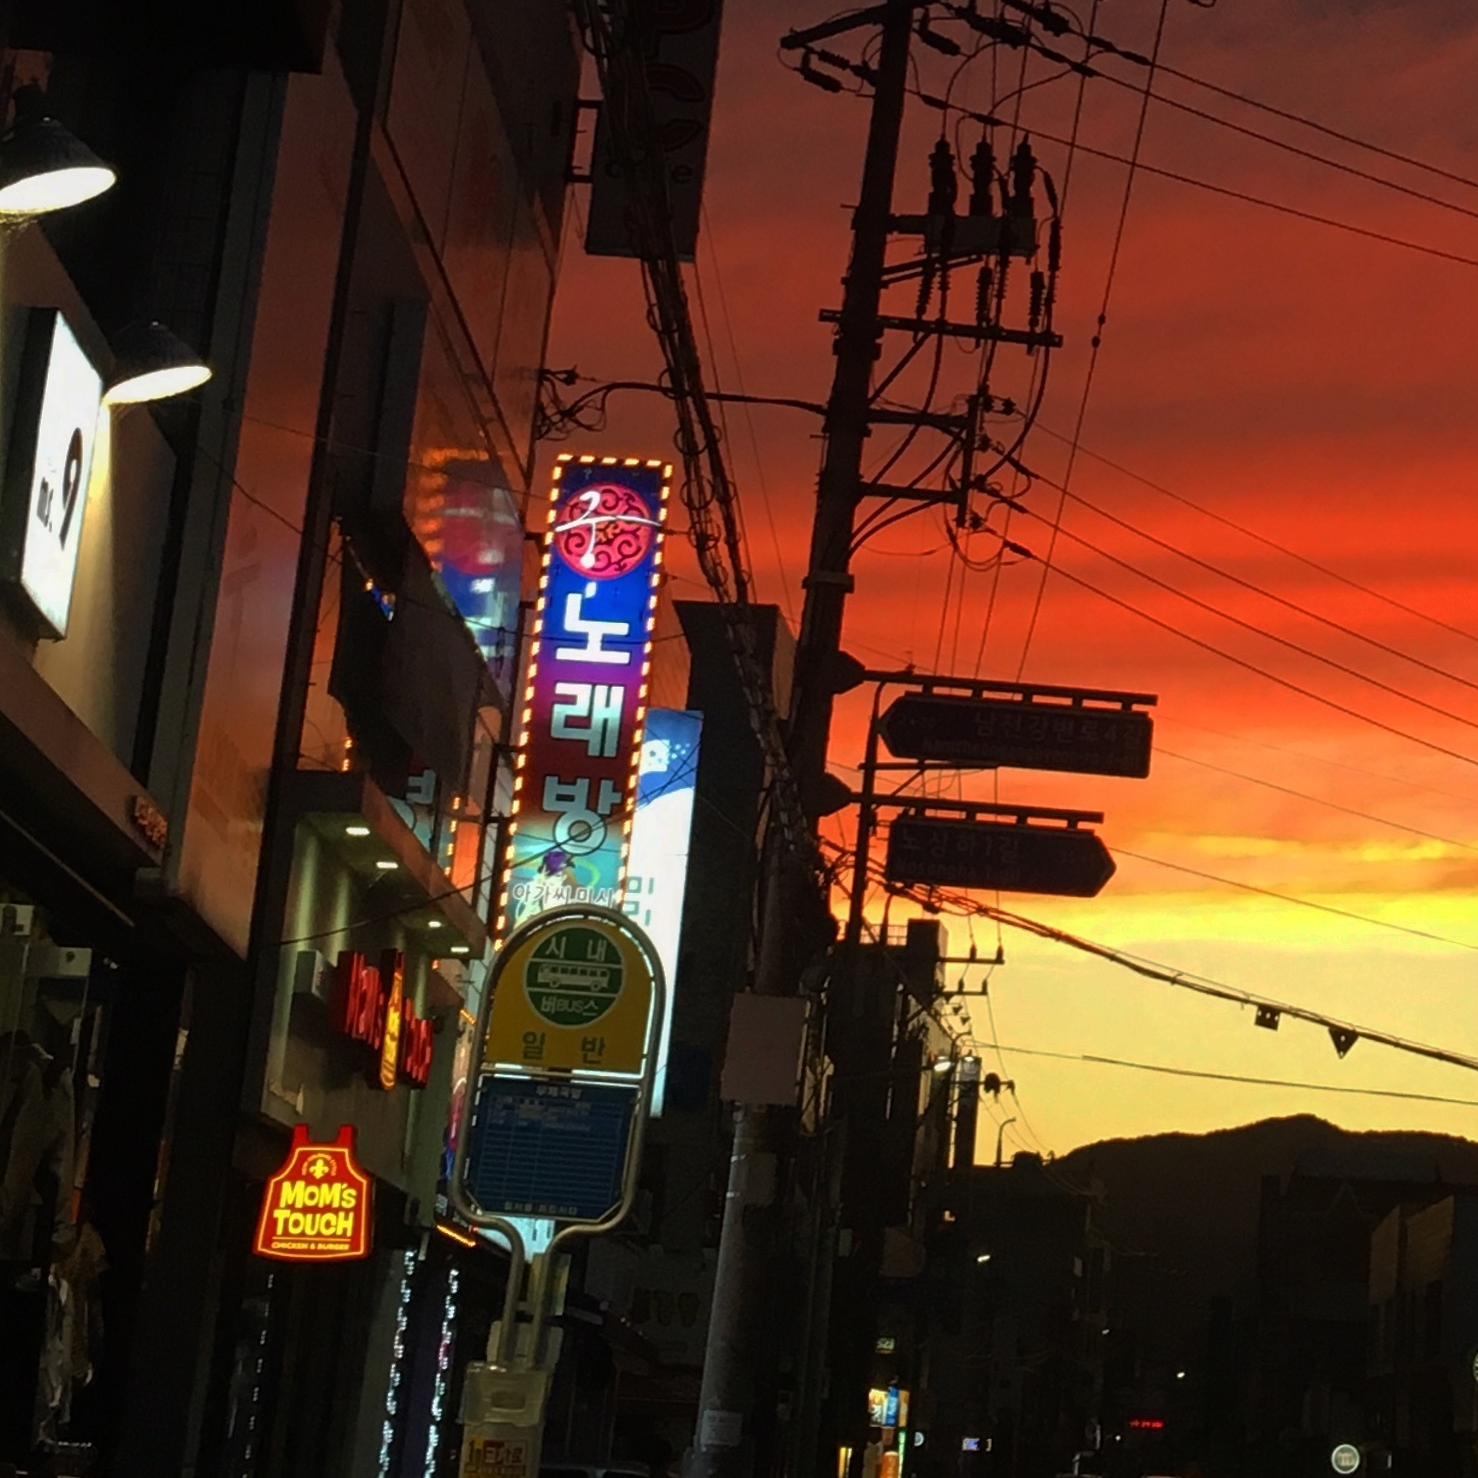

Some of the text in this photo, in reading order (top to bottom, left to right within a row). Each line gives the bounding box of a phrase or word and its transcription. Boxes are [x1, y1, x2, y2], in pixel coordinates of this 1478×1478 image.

[540, 592, 632, 856] 노래방
[900, 827, 1020, 865] 노상하1길
[273, 1209, 355, 1238] TOUCH
